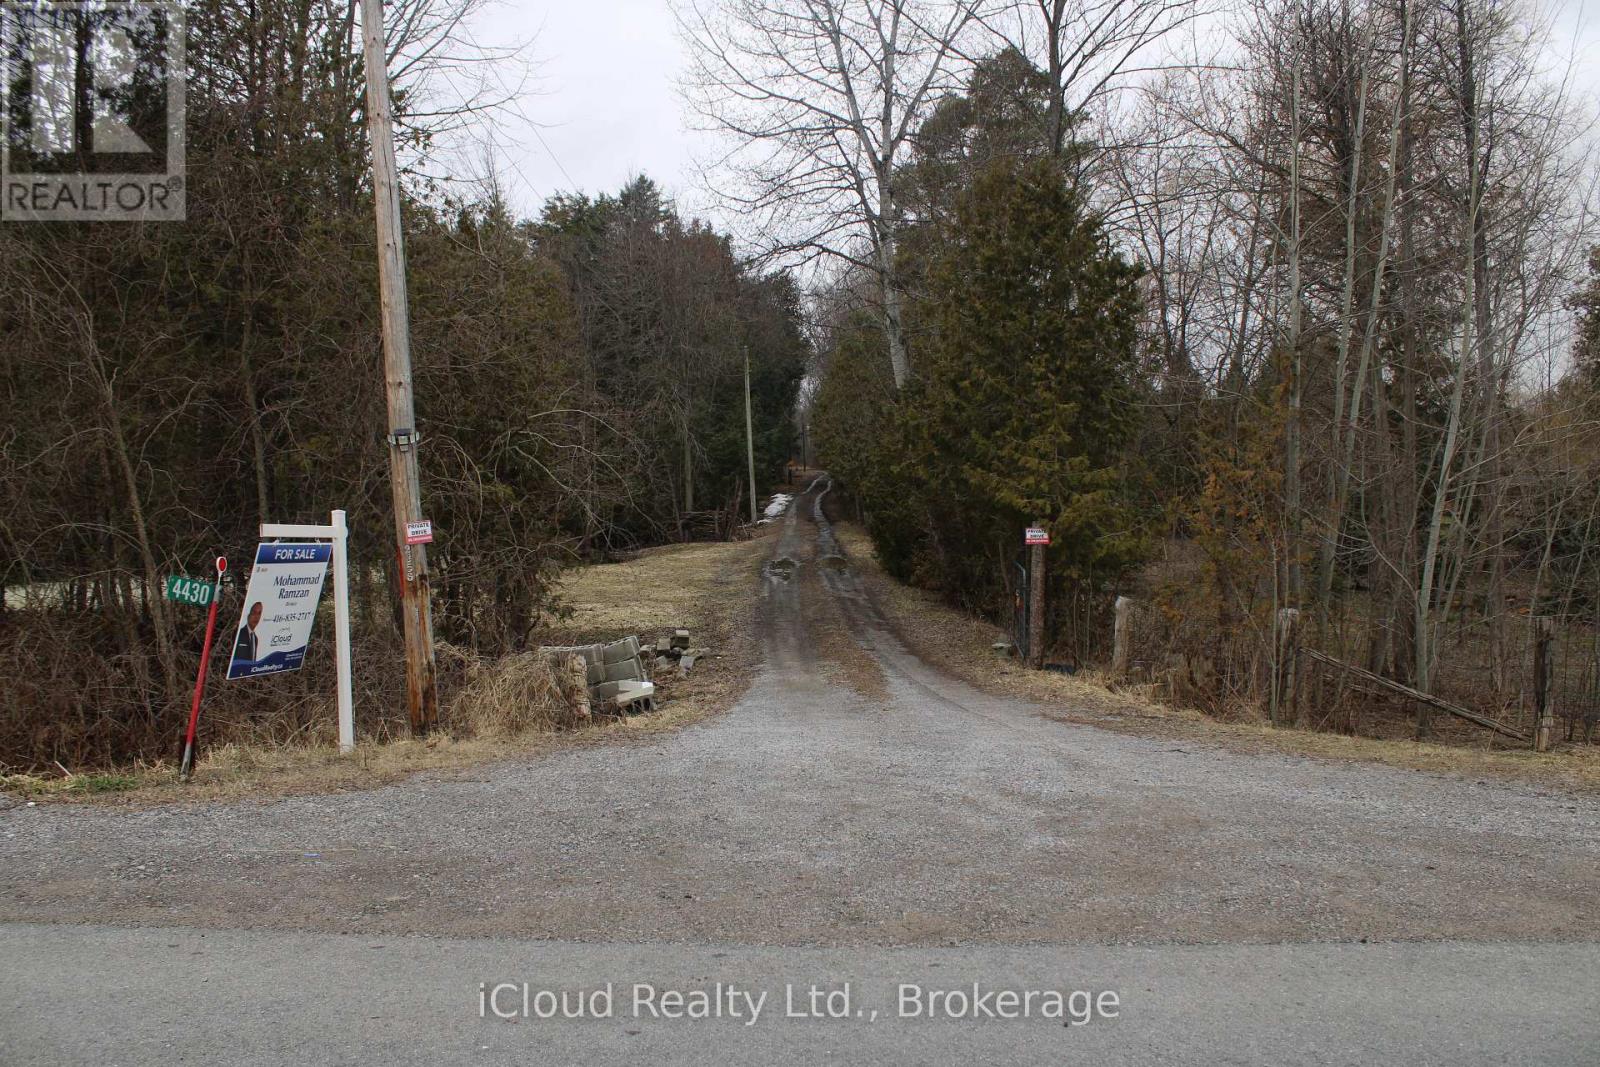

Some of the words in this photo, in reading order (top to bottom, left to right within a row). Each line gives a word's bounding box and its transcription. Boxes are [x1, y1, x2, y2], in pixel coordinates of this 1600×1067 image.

[274, 549, 292, 560] FOR
[294, 548, 316, 559] SALE
[273, 573, 321, 587] Mohammad
[172, 579, 210, 605] 4430
[278, 587, 310, 600] Ramzan
